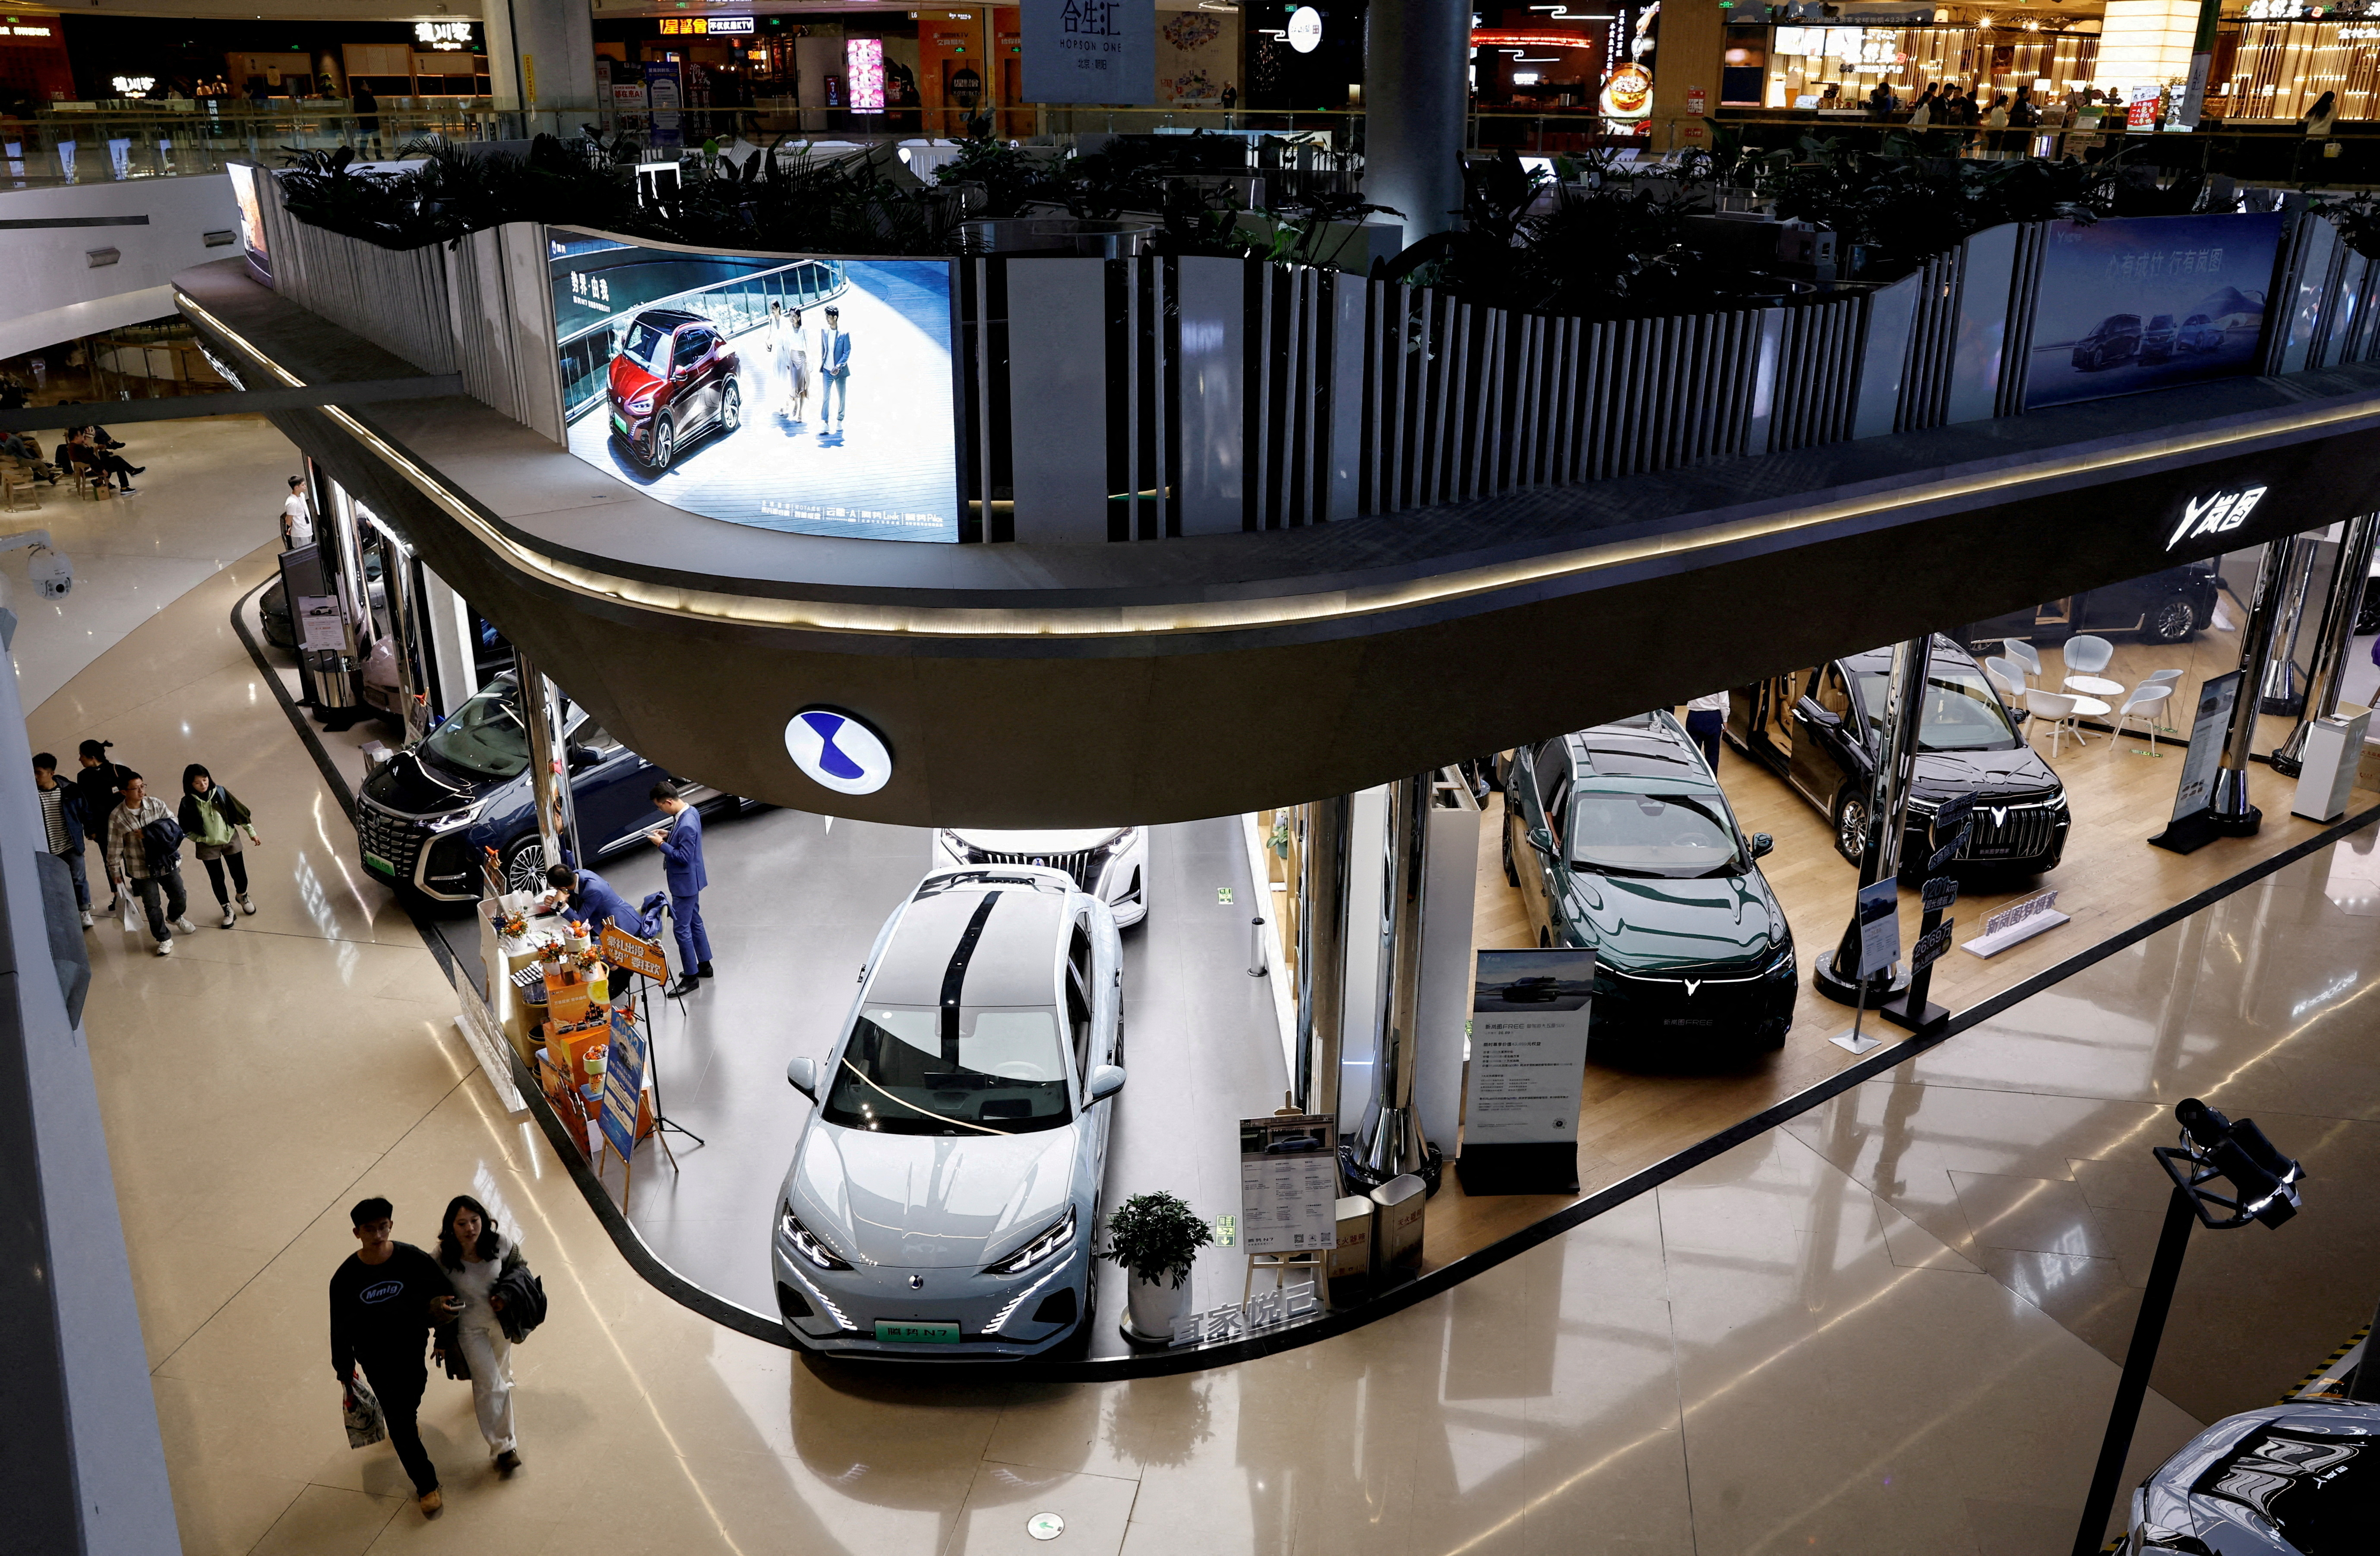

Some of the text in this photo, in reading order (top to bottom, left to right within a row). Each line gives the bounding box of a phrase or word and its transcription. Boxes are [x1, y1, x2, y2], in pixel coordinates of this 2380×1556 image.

[710, 21, 752, 30] 不仅仅是KTV
[1060, 0, 1121, 36] 合生汇
[1060, 39, 1121, 52] HOPSON ONE
[1078, 58, 1106, 70] 北京·朝阳
[2168, 248, 2223, 276] 行有岚图
[570, 270, 610, 302] 势界·由我
[794, 511, 821, 520] 智能底盘
[1923, 880, 1957, 898] 1201km
[1925, 896, 1949, 909] 超长续航
[1985, 890, 2058, 937] 新岚图梦想家
[607, 935, 645, 958] 豪礼出没
[1914, 921, 1952, 958] 26.69万
[631, 955, 661, 976] 要狂欢
[888, 1327, 947, 1336] 腾势N7
